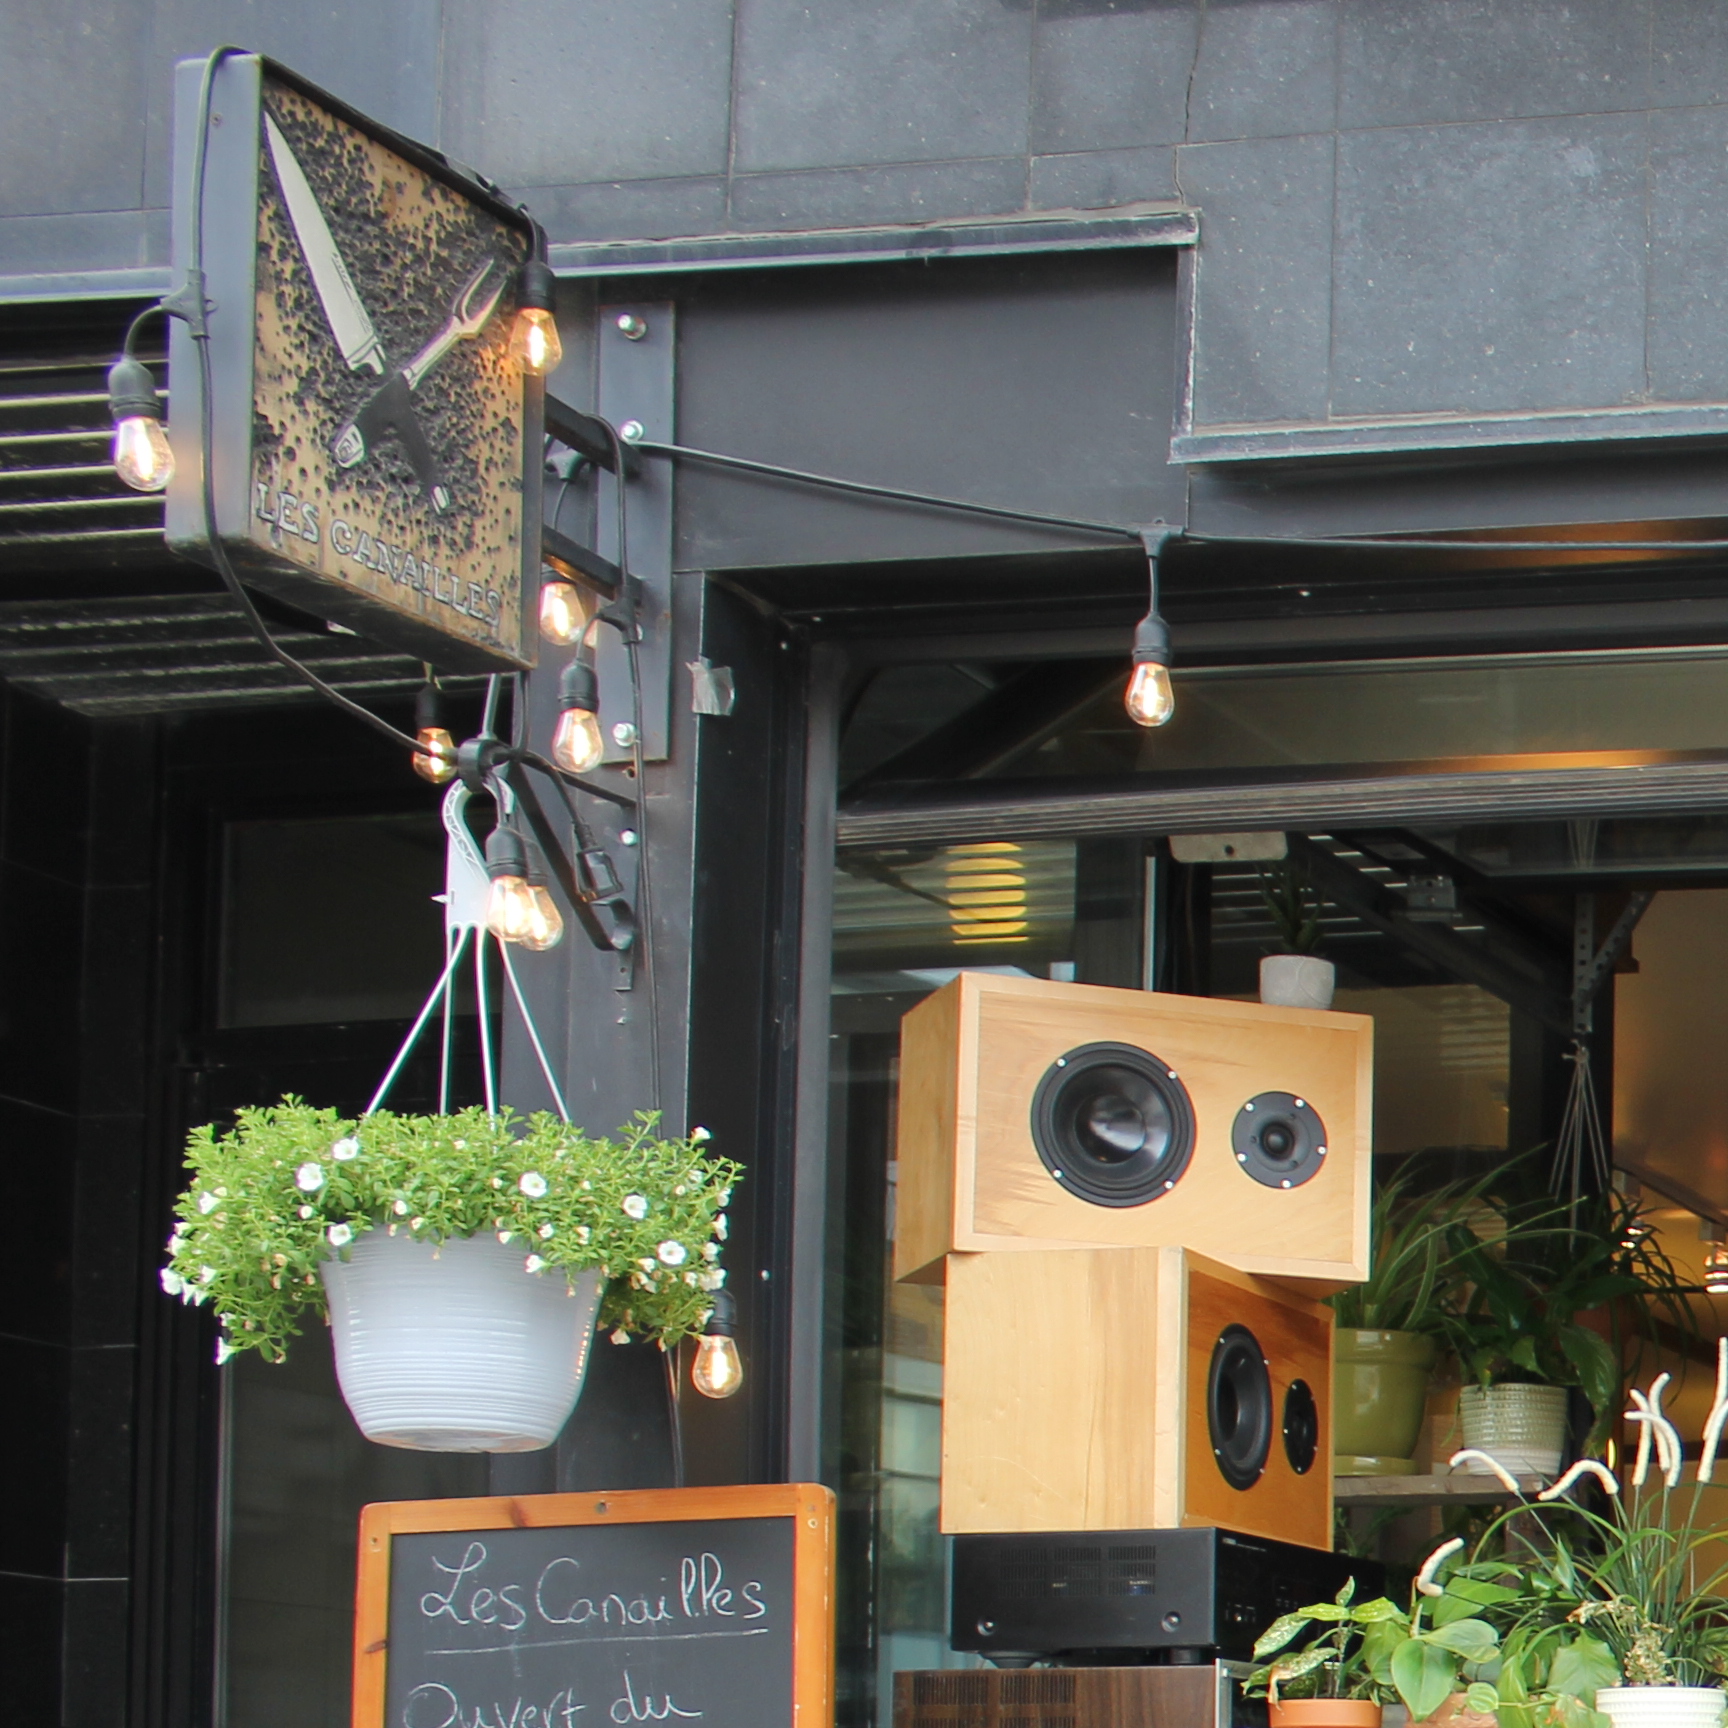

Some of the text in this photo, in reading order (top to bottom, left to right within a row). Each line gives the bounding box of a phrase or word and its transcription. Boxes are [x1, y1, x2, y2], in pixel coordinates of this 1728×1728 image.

[256, 482, 502, 626] LES CANAILLES
[420, 1541, 767, 1631] Les Canailles
[610, 1669, 703, 1725] du
